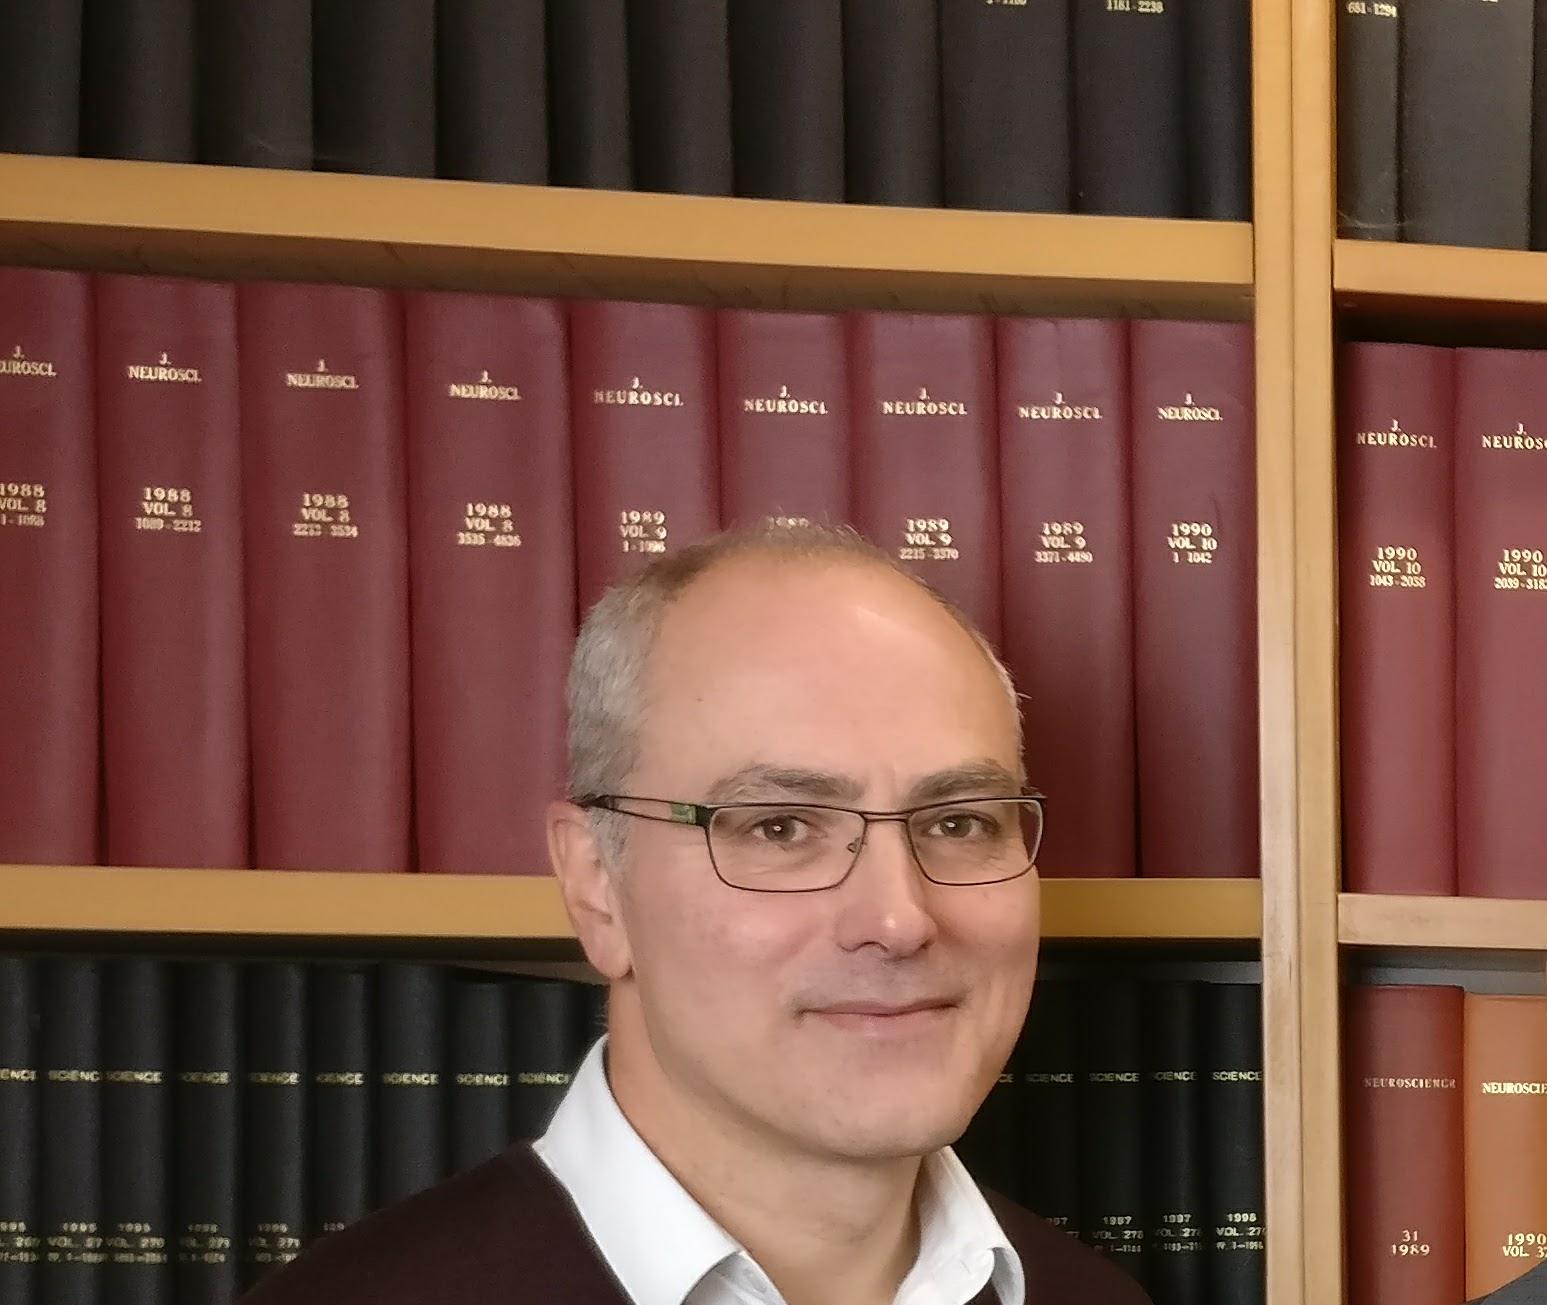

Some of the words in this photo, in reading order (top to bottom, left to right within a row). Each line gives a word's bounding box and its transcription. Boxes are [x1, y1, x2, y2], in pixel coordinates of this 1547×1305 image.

[144, 488, 191, 502] 1988
[303, 494, 348, 508] 1988
[182, 504, 193, 517] 8
[466, 503, 512, 518] 1988
[621, 511, 665, 525] 1989
[907, 519, 949, 532] 1989
[1042, 522, 1083, 536] 1989
[1171, 523, 1212, 536] 1990
[655, 527, 667, 540] 9
[938, 533, 952, 546] 9
[1378, 546, 1417, 560] 1990
[1504, 549, 1543, 563] 1990
[1406, 561, 1421, 574] 10
[1532, 564, 1547, 577] 10
[1403, 1230, 1417, 1242] 31
[1508, 1233, 1546, 1245] 1990
[1392, 1244, 1429, 1255] 1989
